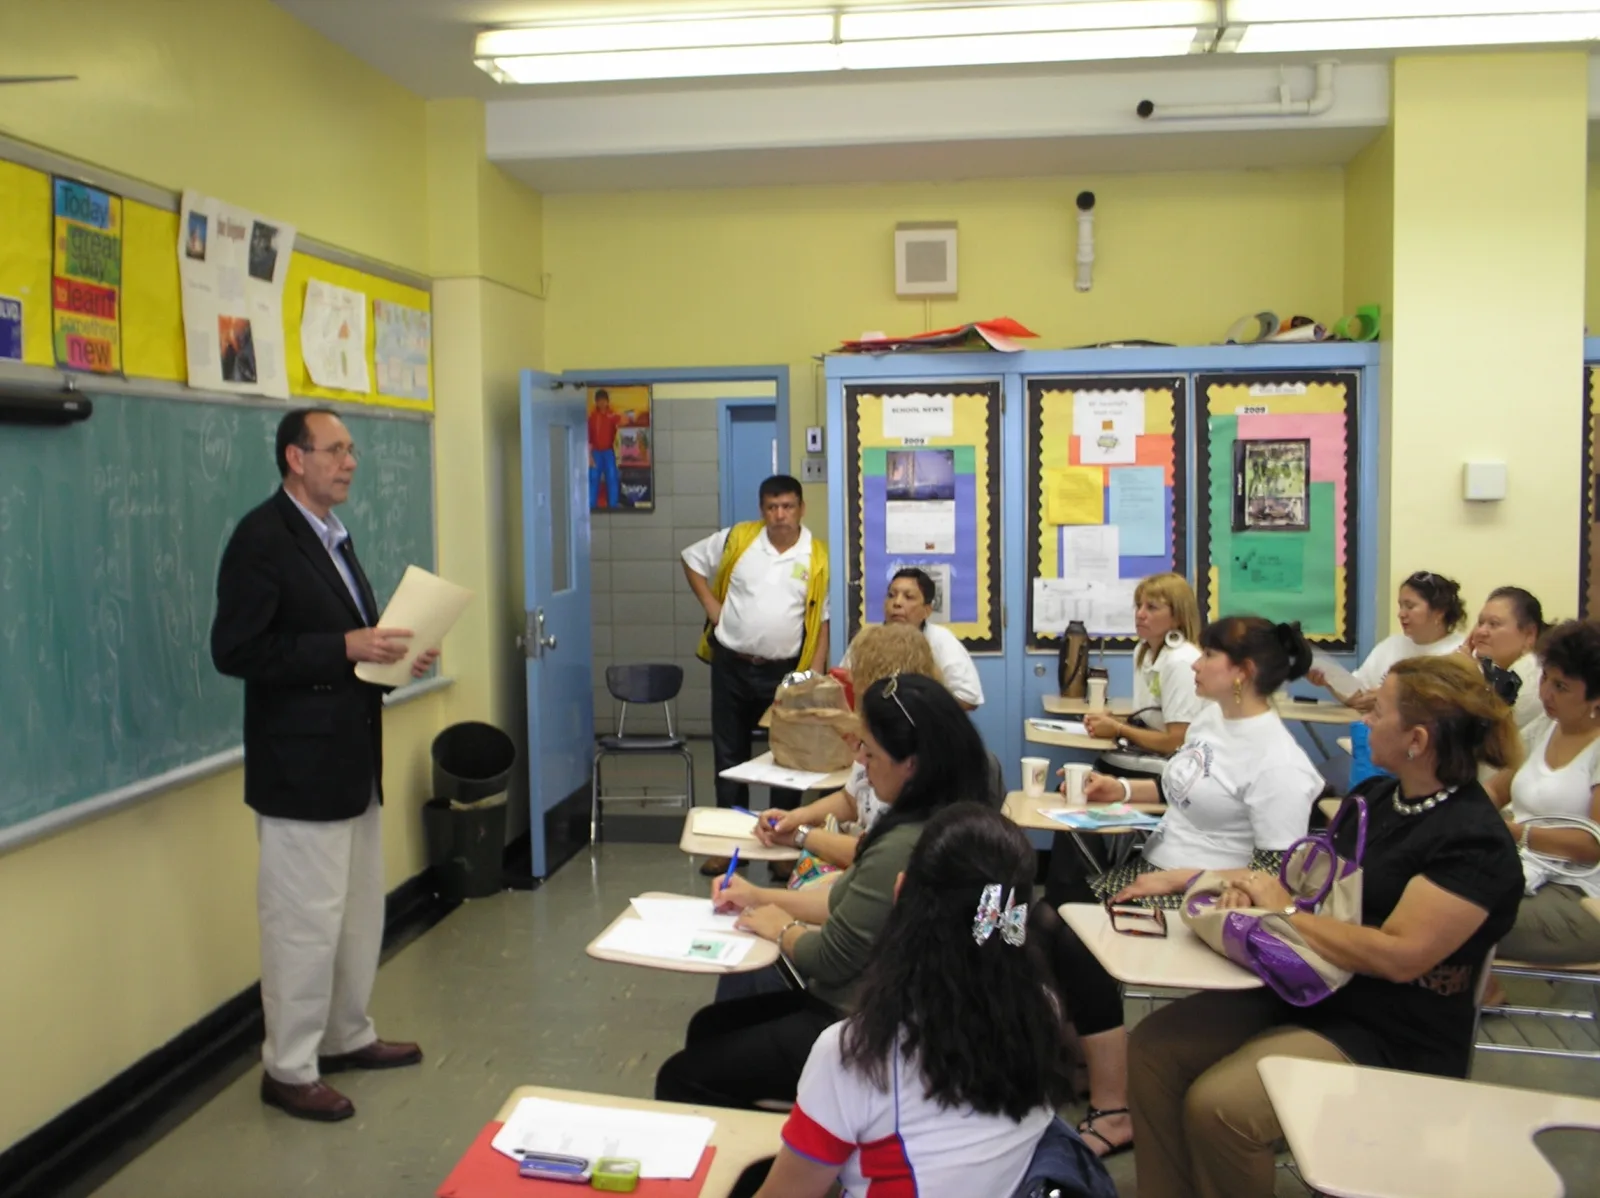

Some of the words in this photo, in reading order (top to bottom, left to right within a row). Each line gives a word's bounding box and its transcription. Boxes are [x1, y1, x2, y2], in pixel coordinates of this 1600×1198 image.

[60, 184, 109, 229] Today
[71, 227, 120, 261] great
[67, 280, 116, 319] learn
[69, 338, 111, 366] new
[1243, 406, 1266, 414] 2009
[904, 437, 925, 445] 2009
